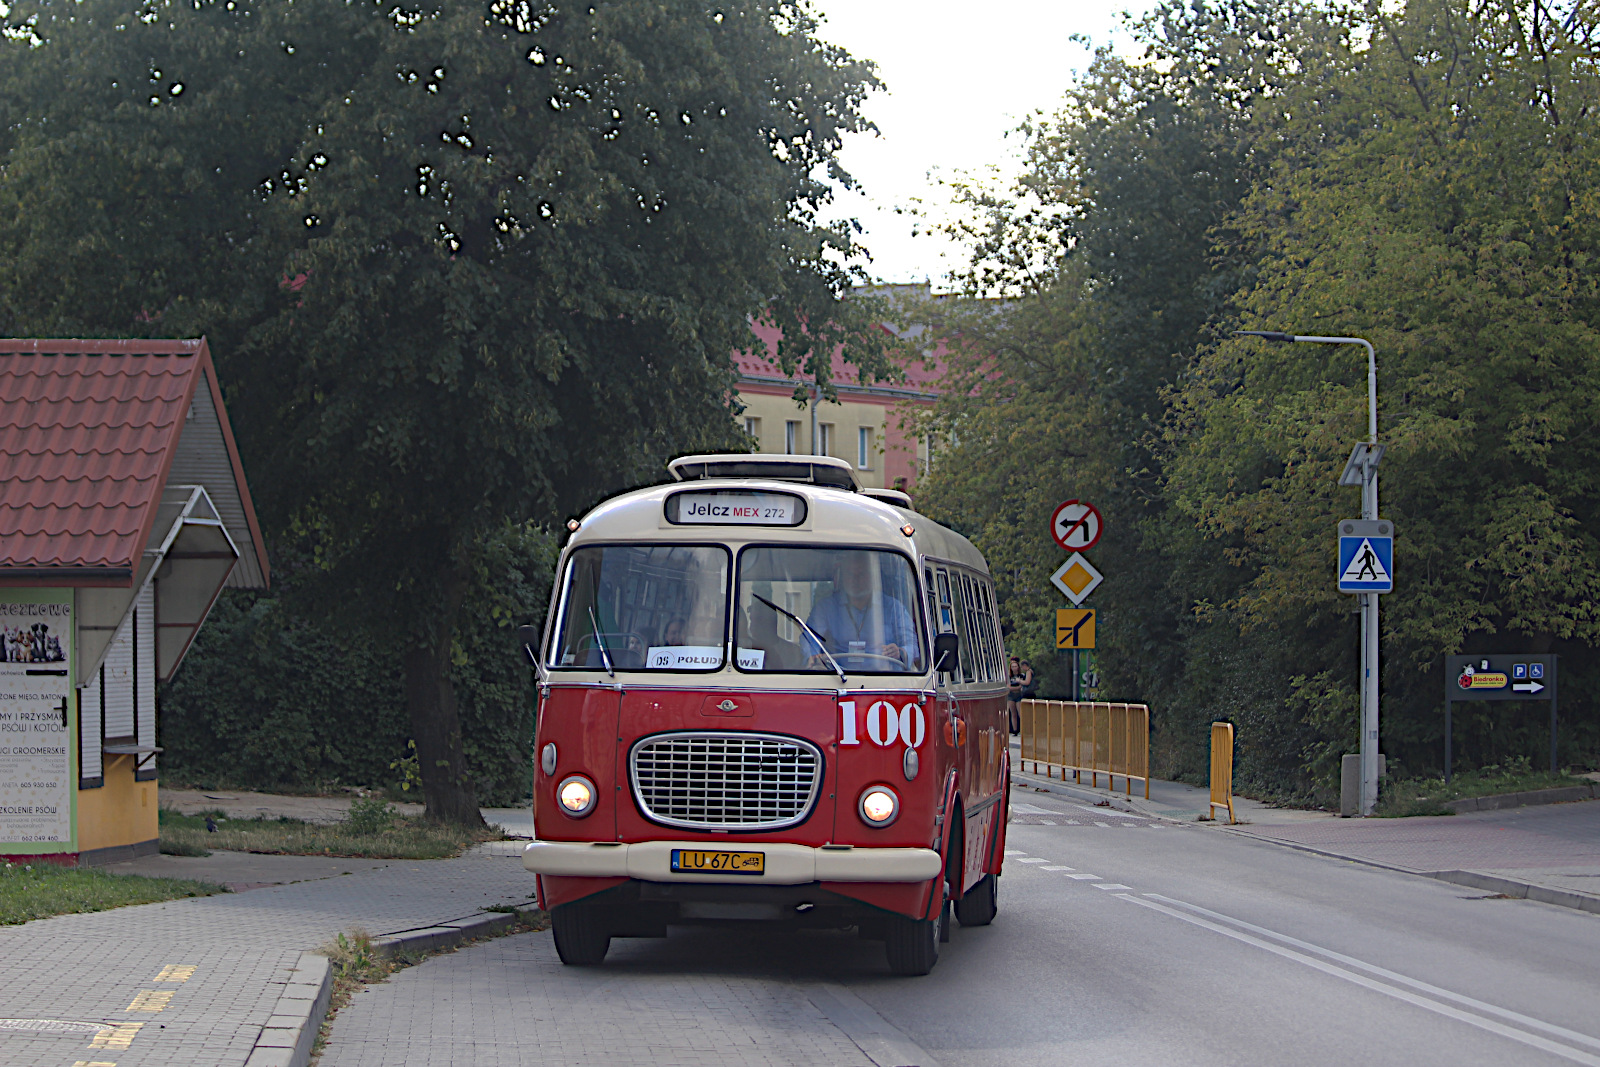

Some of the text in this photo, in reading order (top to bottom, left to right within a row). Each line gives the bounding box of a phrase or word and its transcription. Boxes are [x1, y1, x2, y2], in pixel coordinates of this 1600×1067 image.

[687, 503, 785, 518] Jelcz MEX 272
[1516, 667, 1524, 676] P
[20, 712, 66, 721] PRZYSMAK
[838, 700, 925, 748] 100
[12, 746, 66, 754] GROOMERSKIE
[35, 805, 57, 814] PSÓW
[683, 852, 741, 869] LU 67C
